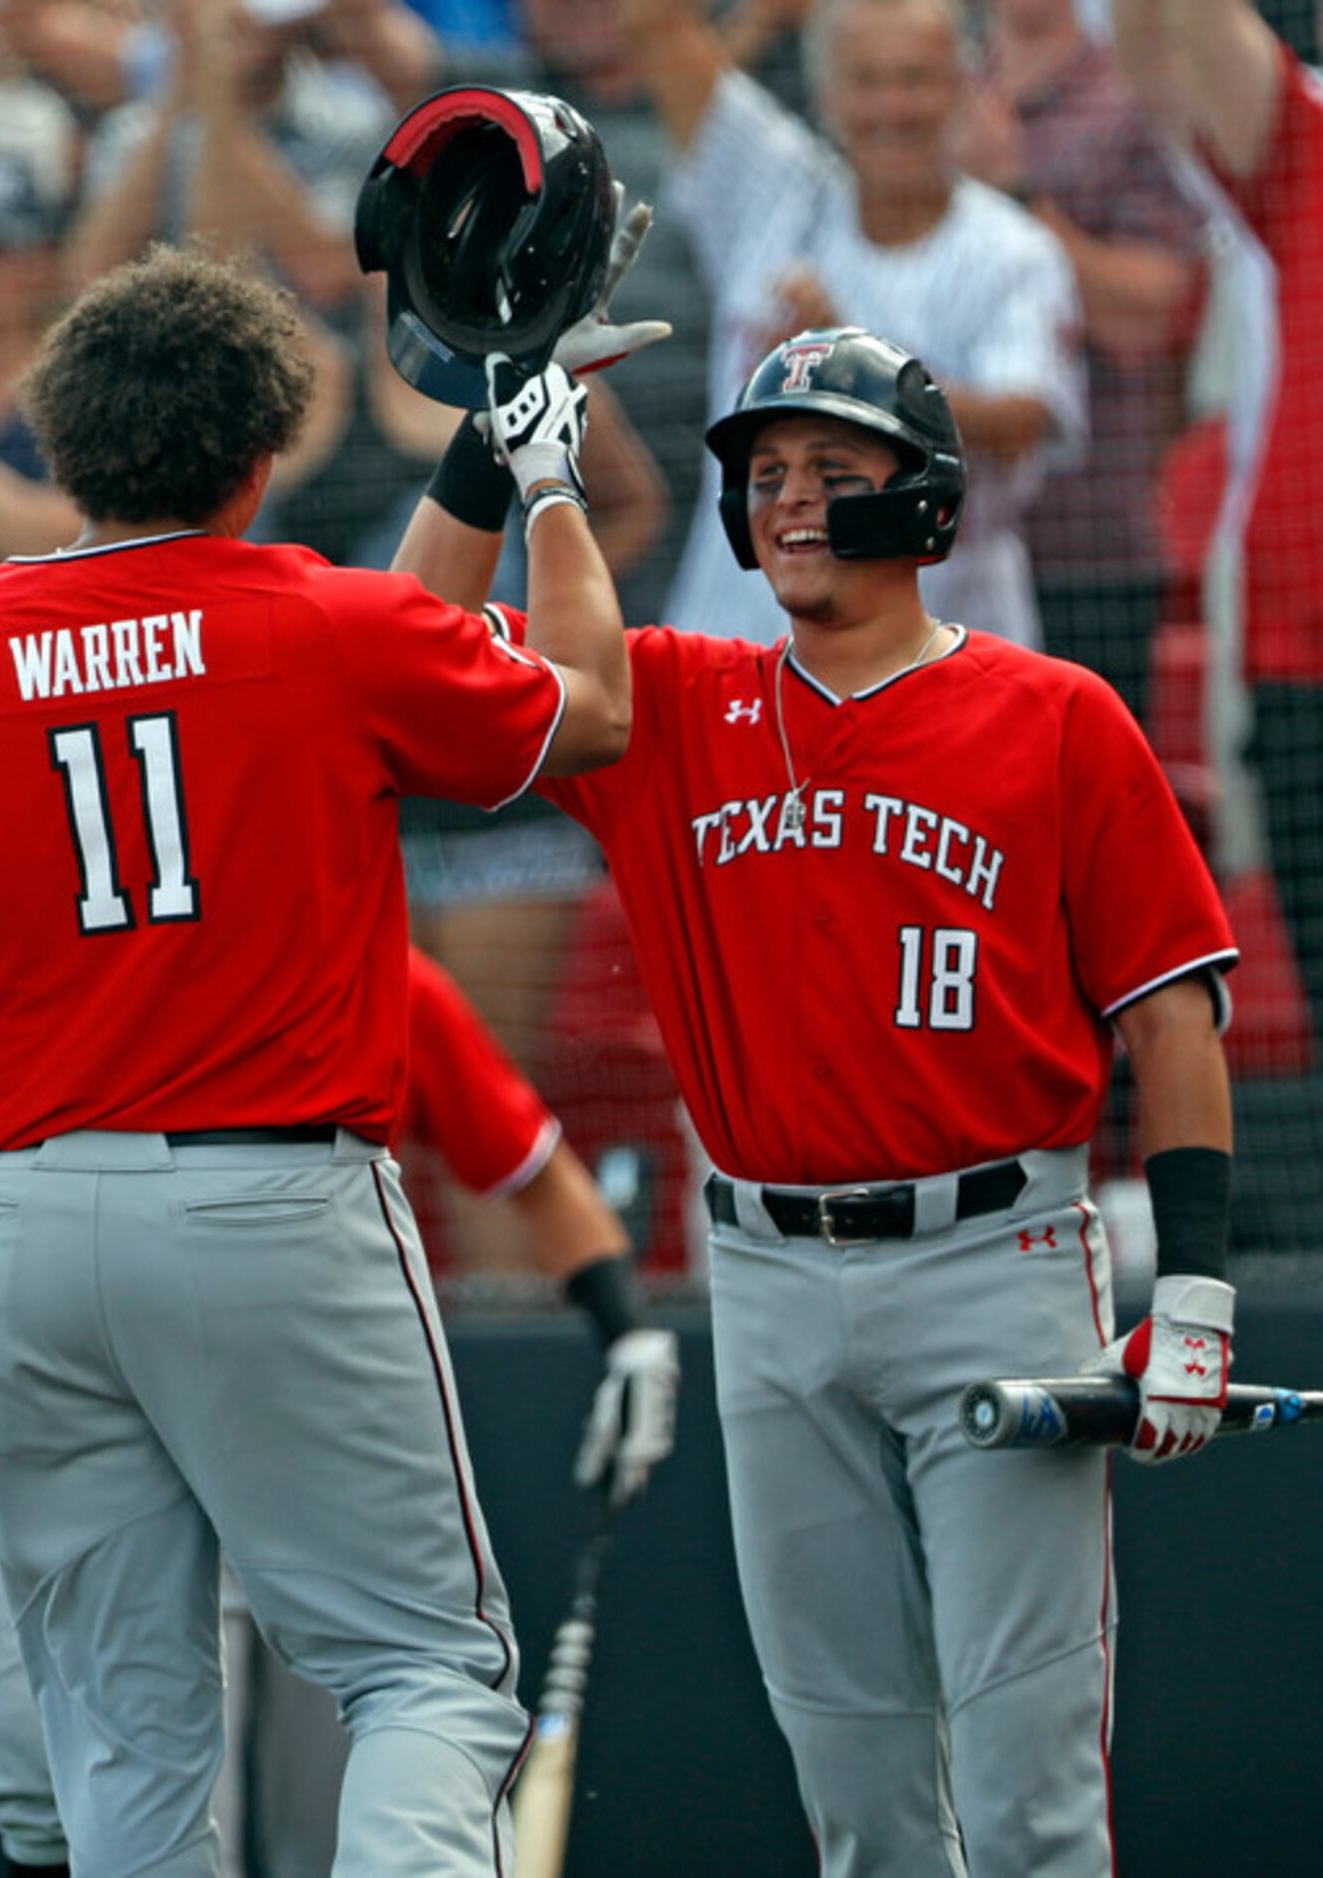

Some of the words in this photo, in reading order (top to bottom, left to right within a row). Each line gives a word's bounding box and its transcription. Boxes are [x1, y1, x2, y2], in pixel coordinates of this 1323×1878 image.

[8, 609, 206, 701] WARREN
[47, 709, 201, 936] 11
[691, 788, 844, 867] TEXAS
[864, 792, 1004, 912] TECH
[895, 925, 978, 1031] 18
